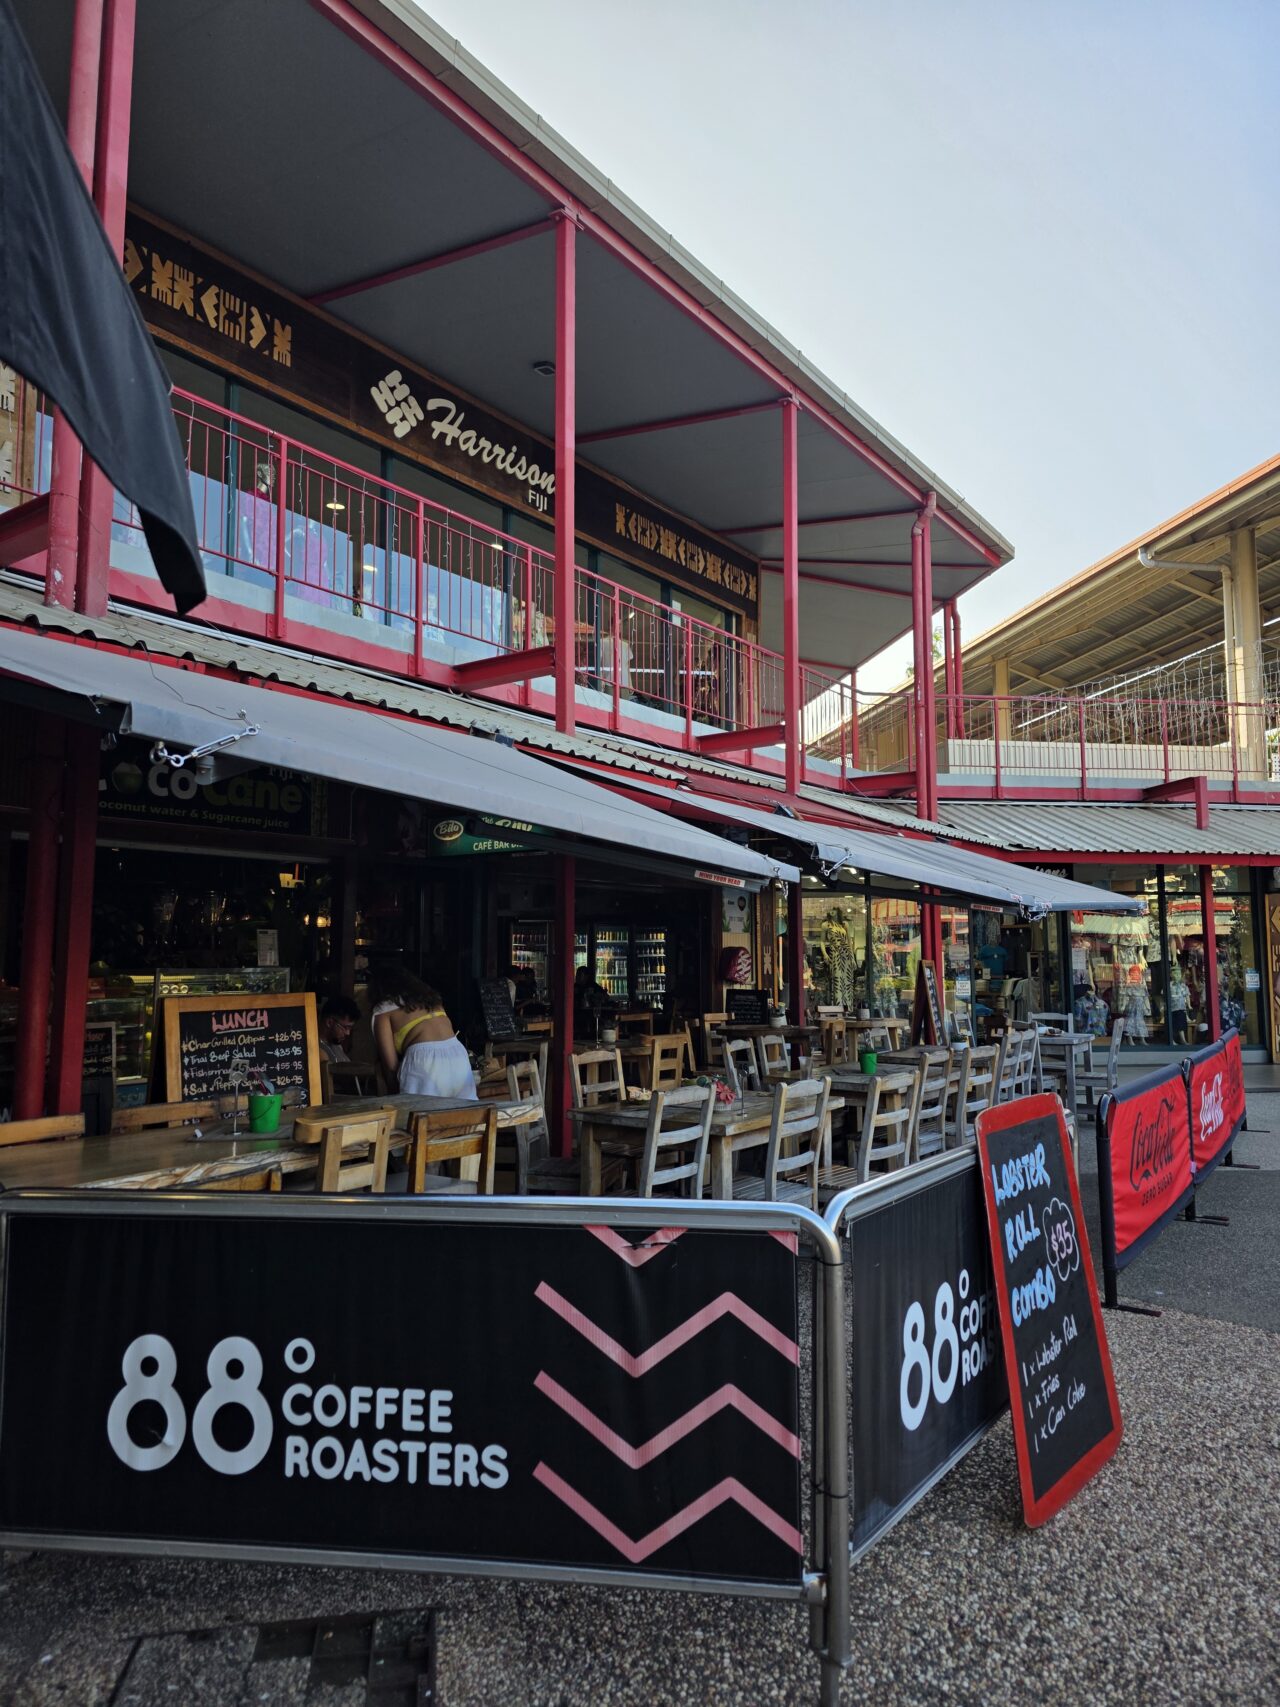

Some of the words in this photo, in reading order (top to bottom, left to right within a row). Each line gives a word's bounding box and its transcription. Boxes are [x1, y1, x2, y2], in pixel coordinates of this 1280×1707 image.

[426, 398, 556, 495] Harrison
[528, 489, 547, 512] FIJI
[99, 799, 145, 813] oconut
[150, 804, 186, 817] water
[190, 807, 199, 818] &
[202, 808, 261, 825] Sugarcane
[473, 839, 493, 851] CAFÉ
[211, 1009, 269, 1033] LUNCH
[232, 1044, 256, 1059] Salad
[1005, 1203, 1041, 1264] ROLL
[1051, 1220, 1073, 1259] $35
[1030, 1362, 1036, 1376] x
[281, 1383, 454, 1434] COFFEE
[1035, 1394, 1041, 1408] x
[1041, 1423, 1048, 1439] x
[1048, 1405, 1066, 1434] Can
[1067, 1377, 1086, 1410] Coke
[284, 1435, 509, 1490] ROASTERS
